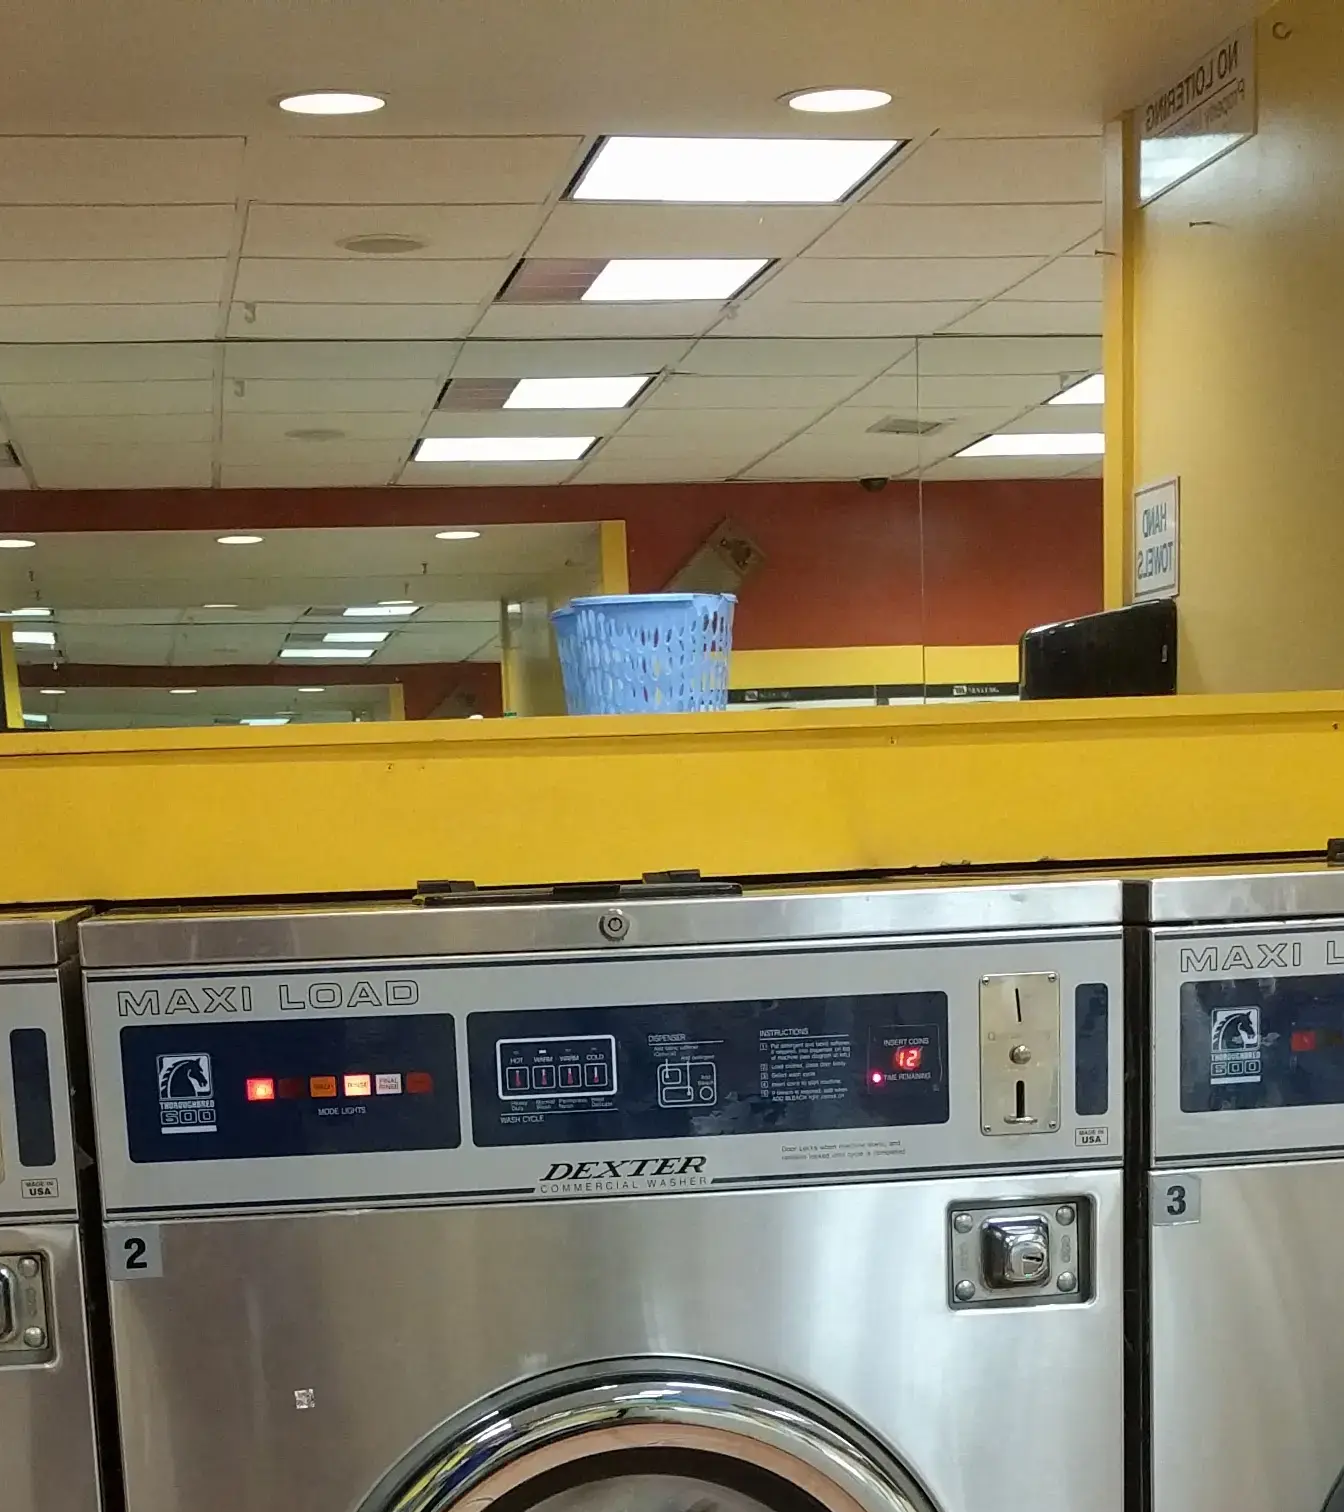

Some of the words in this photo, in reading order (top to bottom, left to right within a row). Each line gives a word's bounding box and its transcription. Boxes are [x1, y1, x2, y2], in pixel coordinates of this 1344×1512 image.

[1180, 942, 1302, 973] MAXI
[117, 985, 252, 1017] MAXI
[279, 979, 419, 1010] LOAD
[760, 1028, 809, 1037] INSTRUCTIONS
[883, 1038, 907, 1046] INSERT
[908, 1037, 930, 1045] COINS
[899, 1049, 918, 1067] 12
[318, 1107, 339, 1116] MODE
[341, 1106, 366, 1115] LIGHTS
[500, 1116, 521, 1124] WASH
[523, 1114, 545, 1123] CYCLE
[1082, 1135, 1102, 1144] USA
[539, 1155, 707, 1182] DEXTER
[29, 1187, 51, 1196] USA
[540, 1180, 639, 1194] COMMERCIAL
[647, 1176, 708, 1189] WASHER
[1167, 1185, 1187, 1216] 3
[124, 1237, 148, 1270] 2
